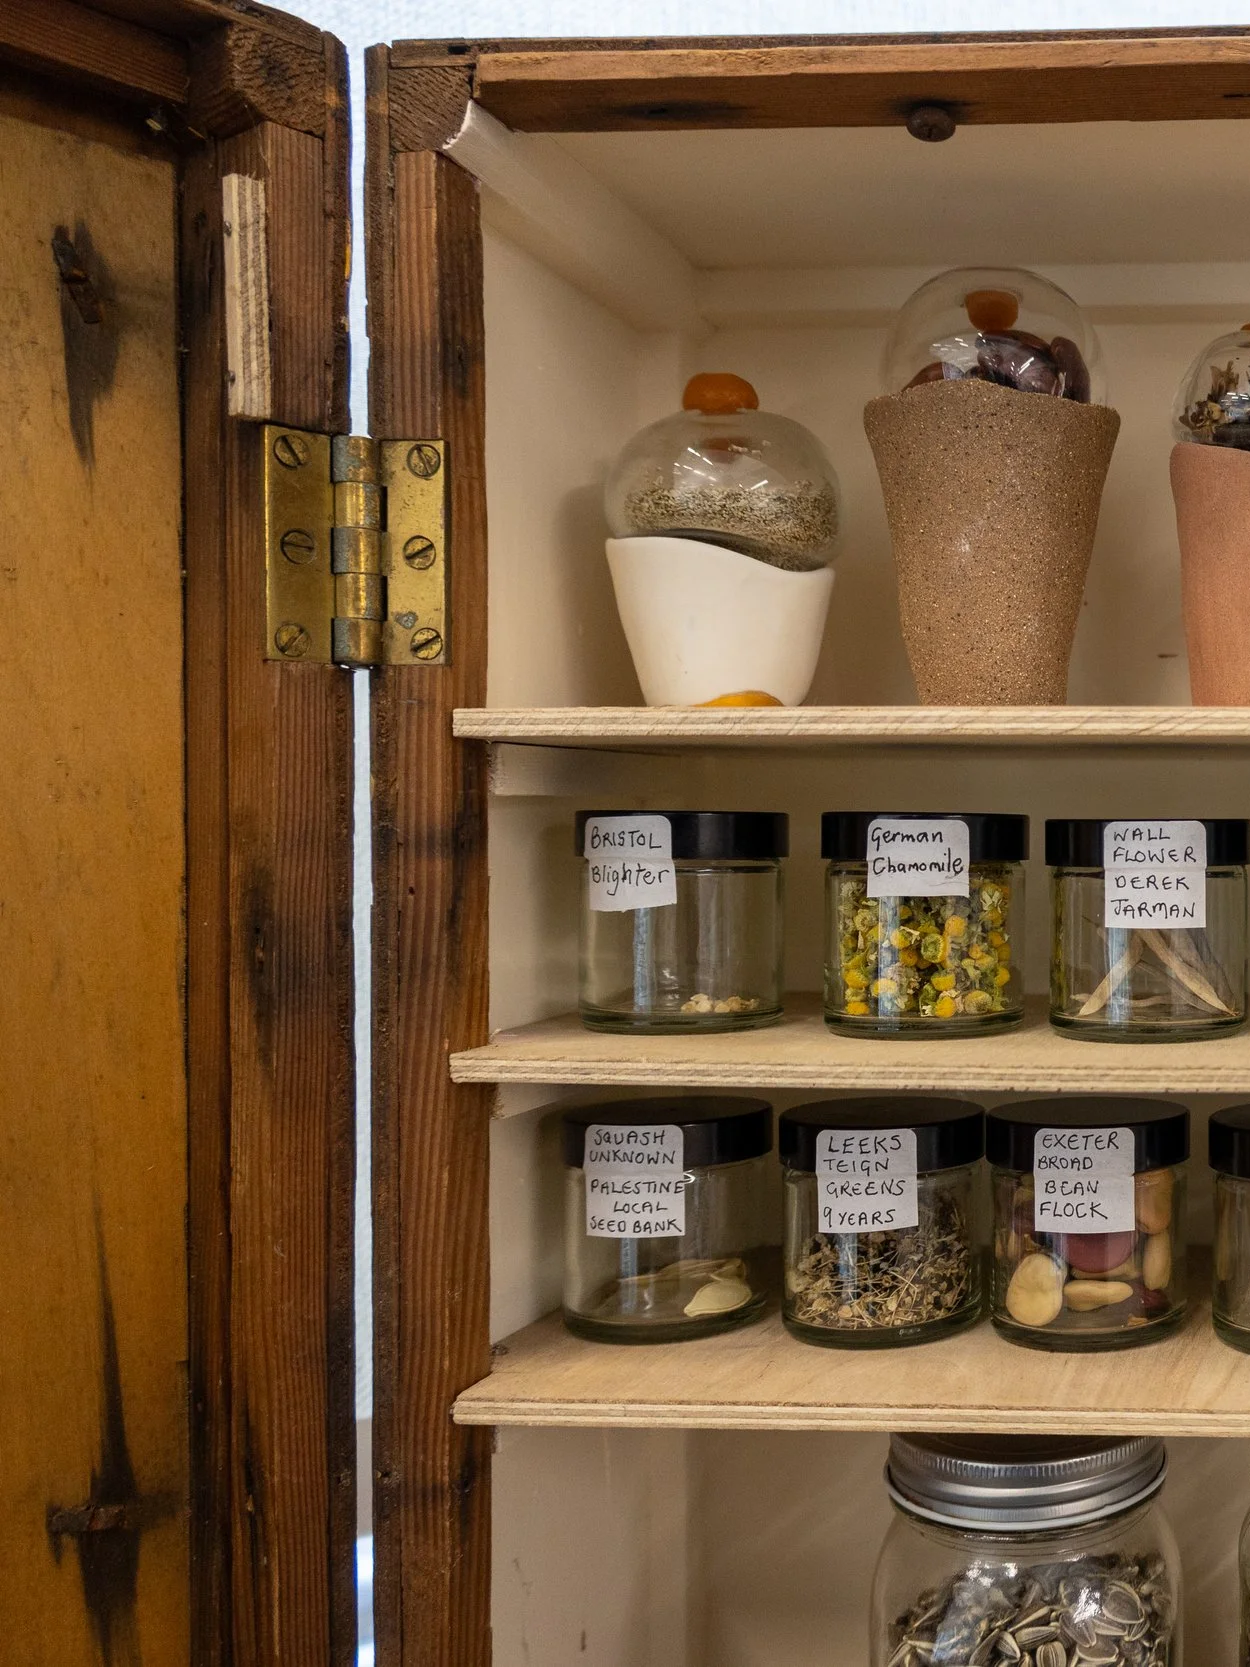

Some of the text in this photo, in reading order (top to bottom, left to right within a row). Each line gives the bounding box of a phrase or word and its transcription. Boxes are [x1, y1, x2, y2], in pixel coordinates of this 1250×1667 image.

[591, 826, 662, 849] BRISTOL
[871, 827, 944, 851] German
[1113, 828, 1171, 841] WALL
[872, 847, 964, 875] Chamomile
[1113, 846, 1197, 864] FLOWER
[591, 863, 670, 896] Blighter
[1115, 874, 1190, 890] DEREK
[1110, 899, 1196, 919] JARMAN
[594, 1129, 665, 1146] SQUASH
[828, 1135, 902, 1154] LEEKS
[1042, 1131, 1119, 1150] EXETER
[589, 1150, 676, 1165] UNKNOWN
[823, 1157, 890, 1177] TEIGN
[1038, 1155, 1094, 1171] BROAD
[591, 1179, 685, 1195] PALESTINE
[826, 1179, 906, 1199] GREENS
[1044, 1180, 1099, 1196] BEAN
[613, 1201, 668, 1214] LOCAL
[823, 1206, 897, 1228] 9 YEARS
[1039, 1201, 1108, 1220] FLOCK
[590, 1216, 683, 1234] SEED BANK
